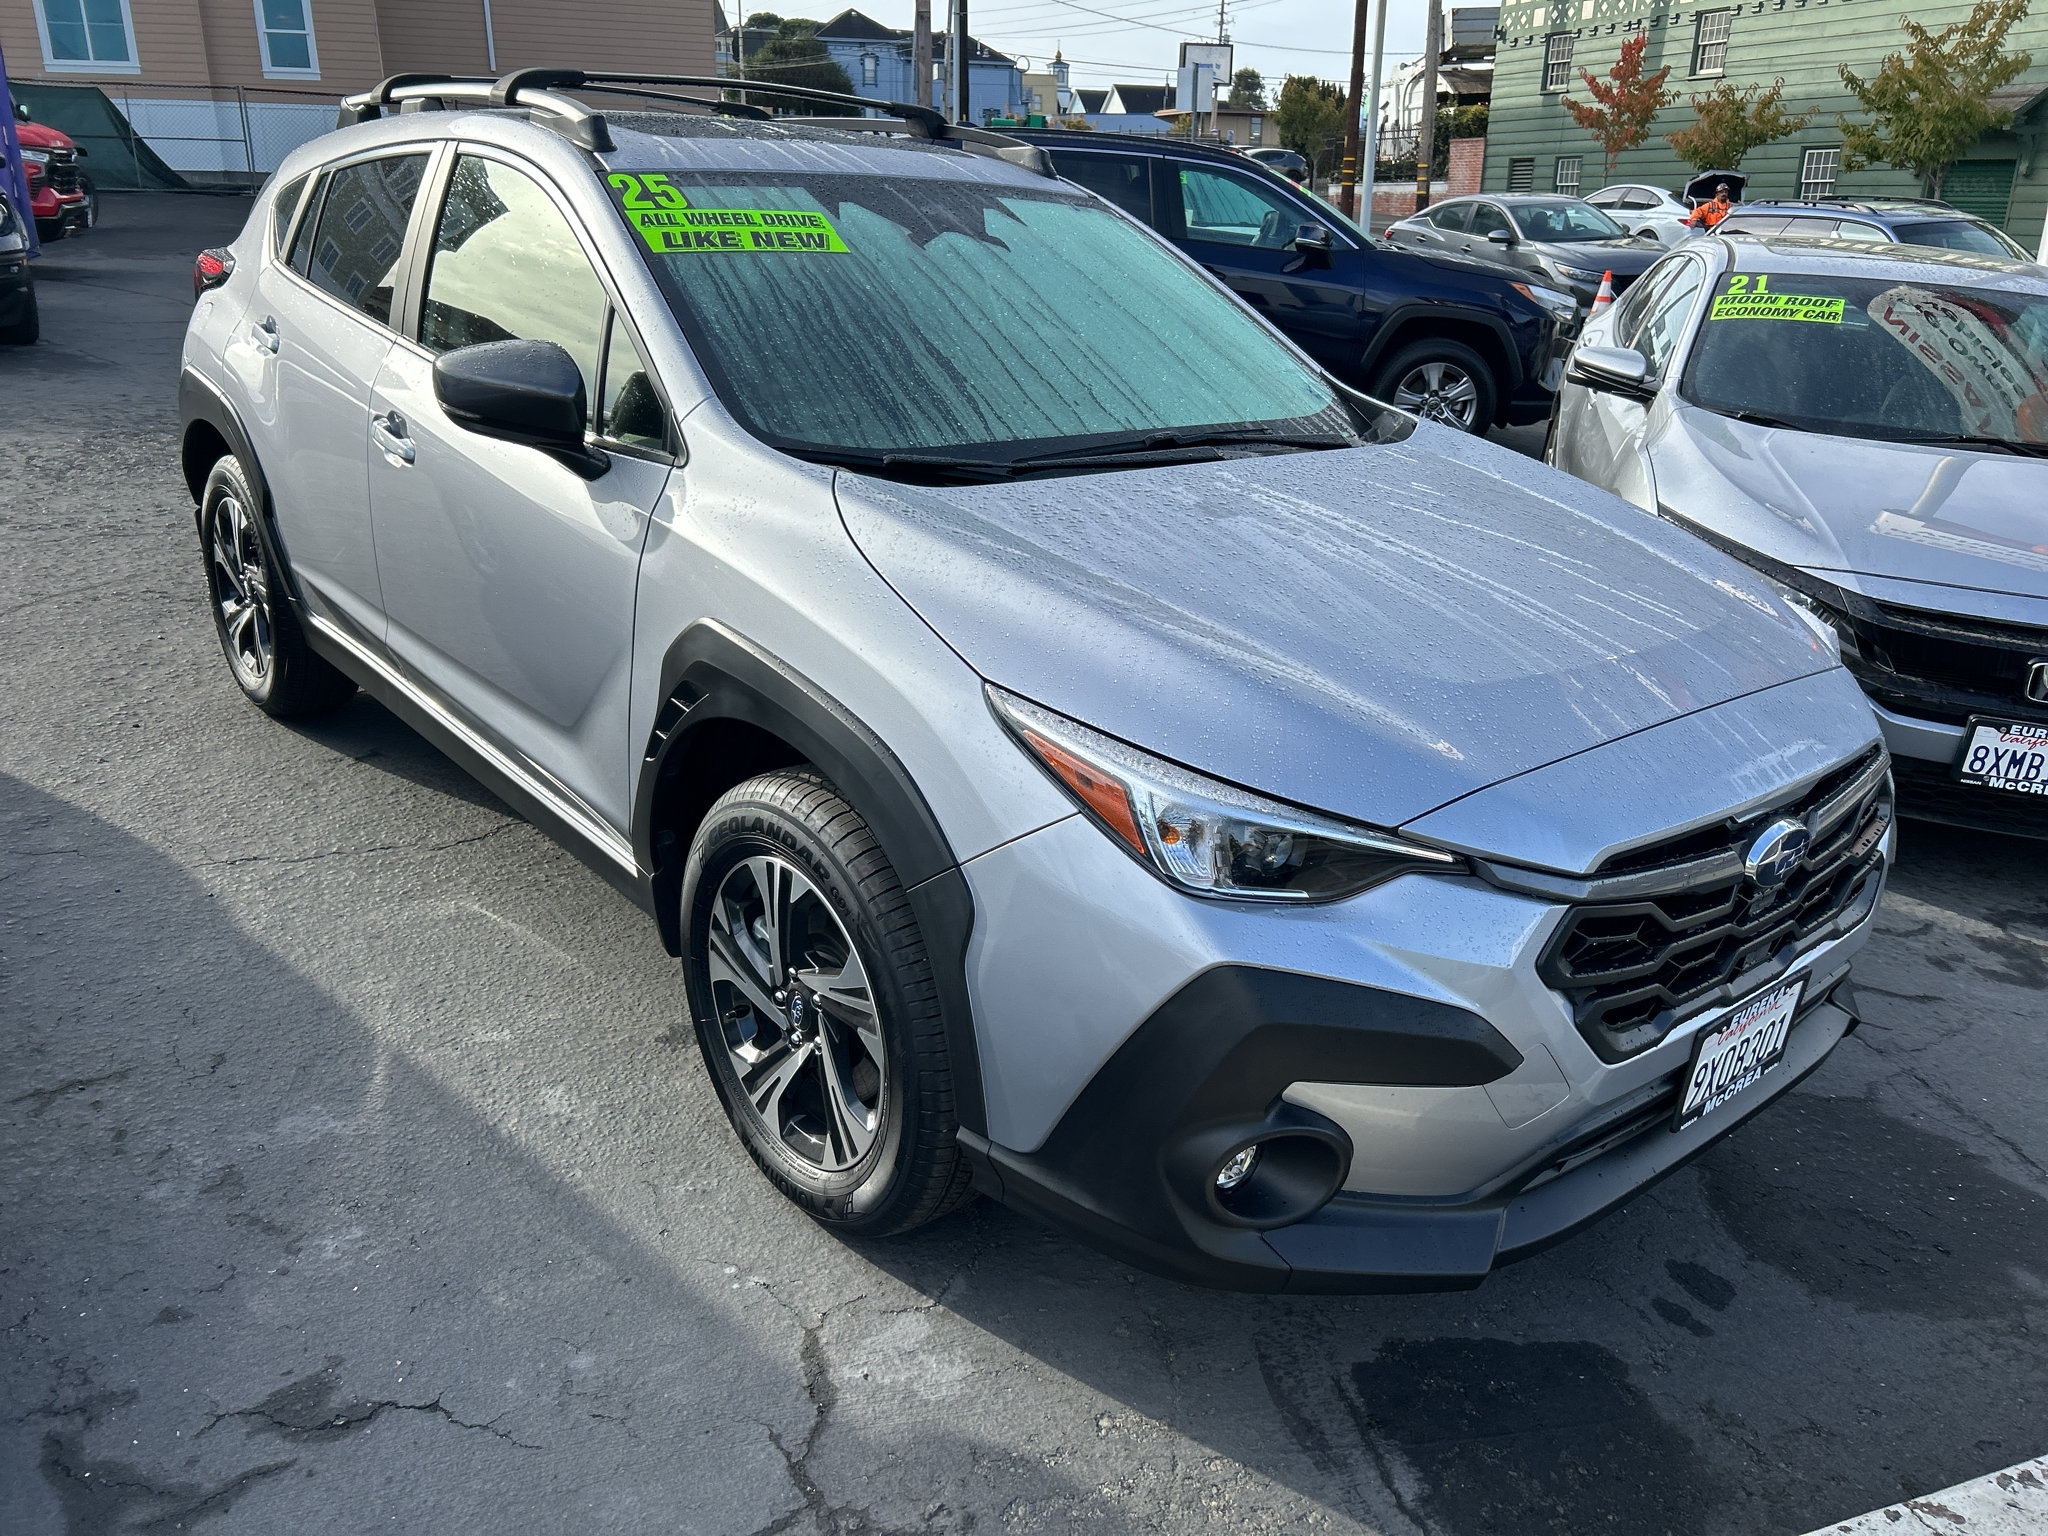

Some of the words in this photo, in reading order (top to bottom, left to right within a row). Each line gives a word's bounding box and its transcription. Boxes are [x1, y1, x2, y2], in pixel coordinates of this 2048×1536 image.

[607, 173, 688, 209] 25
[640, 212, 683, 228] ALL
[686, 212, 762, 229] WHEEL
[760, 214, 824, 230] DRIVE
[662, 231, 743, 250] LIKE
[750, 231, 830, 251] NEW
[1727, 275, 1769, 295] 21
[1718, 295, 1781, 306] MOON
[1784, 297, 1842, 309] ROOF
[1713, 307, 1804, 319] ECONOMY
[1802, 309, 1842, 322] CAR
[2009, 724, 2048, 739] EUR
[1968, 745, 2048, 783] 8XMB
[707, 815, 831, 883] GEOLANDAR
[1730, 986, 1788, 1028] EUREKA
[1702, 1066, 1762, 1116] McCREA
